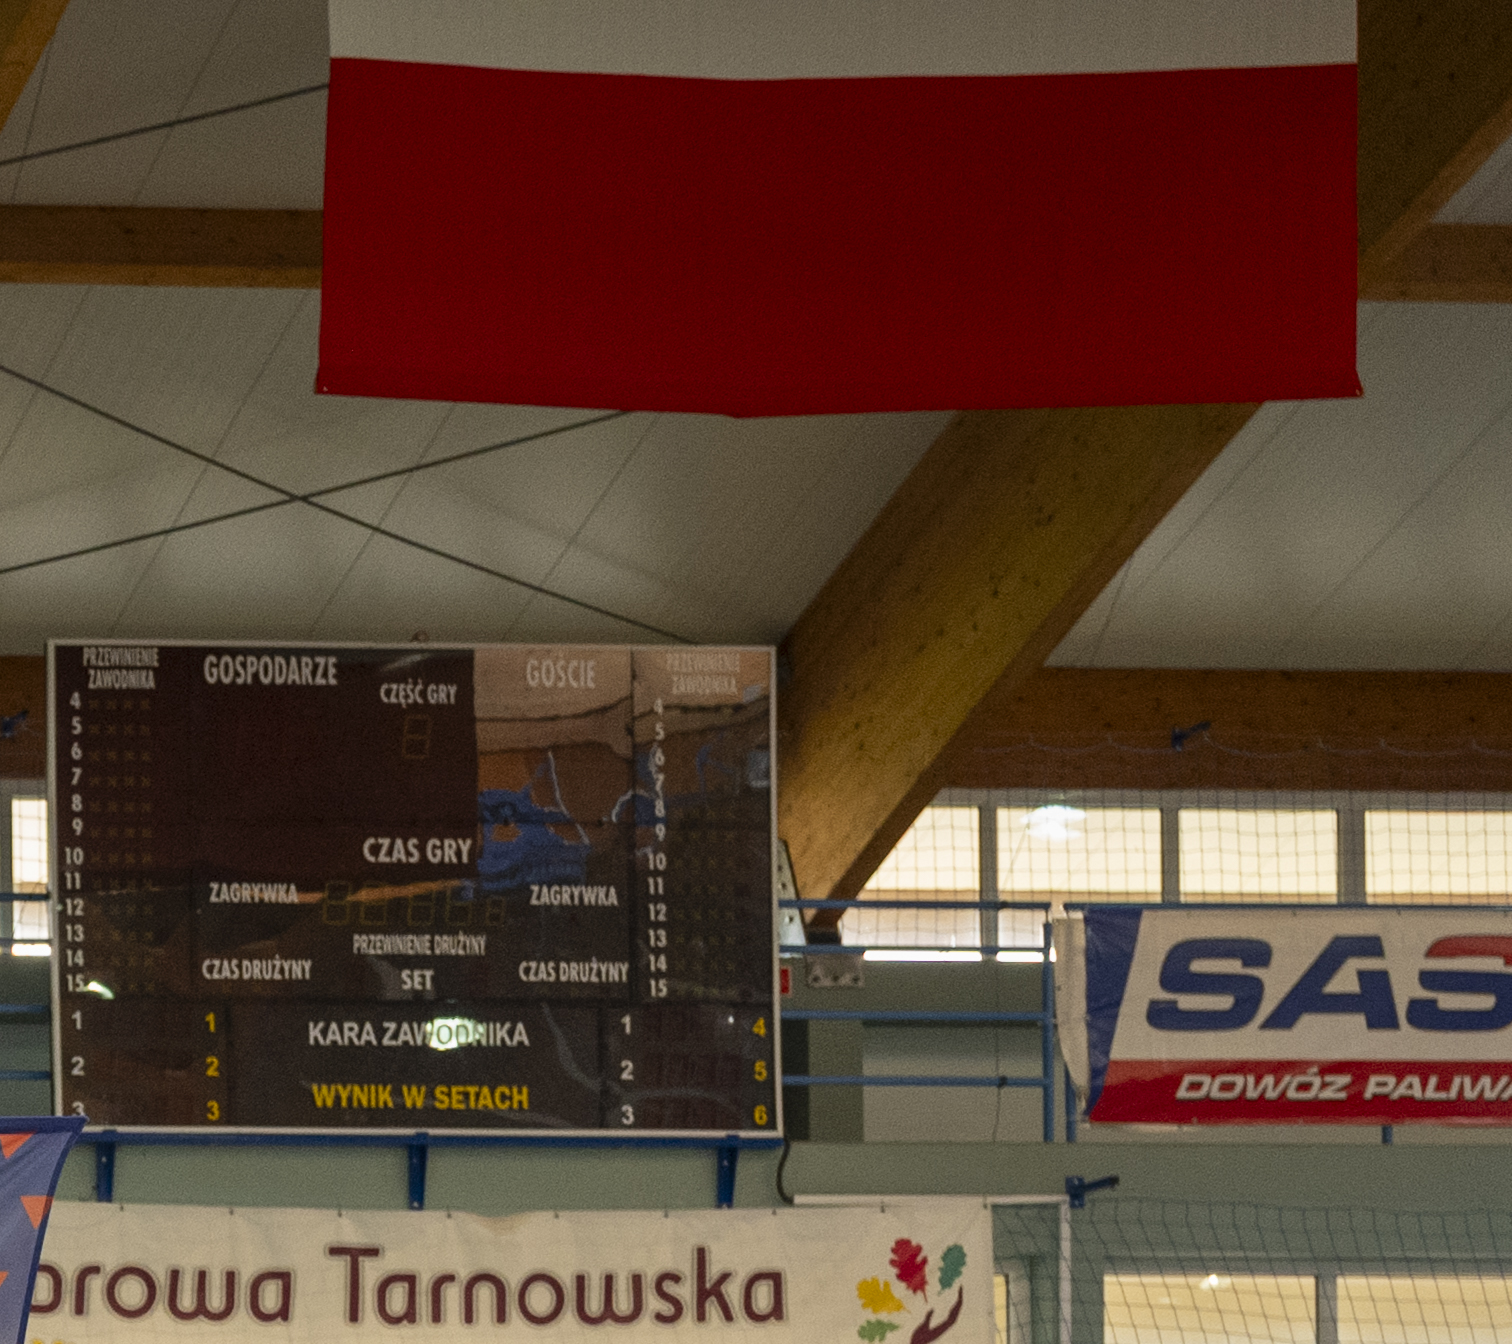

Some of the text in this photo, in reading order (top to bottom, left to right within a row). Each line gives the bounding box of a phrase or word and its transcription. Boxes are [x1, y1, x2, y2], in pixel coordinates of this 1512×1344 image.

[88, 669, 156, 690] ZAWODNIKA
[204, 655, 339, 687] GOSPODARZE
[525, 658, 597, 689] GOŚCIE
[379, 680, 458, 708] CZĘŚĆ GRY
[64, 847, 84, 866] 10
[363, 838, 473, 865] CZAS GRY
[209, 882, 299, 904] ZAGRYWKA
[530, 885, 619, 907] ZAGRYWKA
[64, 898, 84, 917] 12
[434, 930, 486, 957] DRUŻYNY
[202, 954, 313, 982] CZAS DRUŻYNY
[401, 969, 434, 991] SET
[519, 956, 629, 985] CZAS DRUŻYNY
[308, 1021, 530, 1049] KARA ZAWODNIKA
[205, 1057, 220, 1077] 2
[1176, 1065, 1512, 1101] DOWÓZ PALIW
[313, 1085, 530, 1111] WYNIK W SETACH
[206, 1102, 220, 1122] 3
[326, 1245, 787, 1327] Tarnowska
